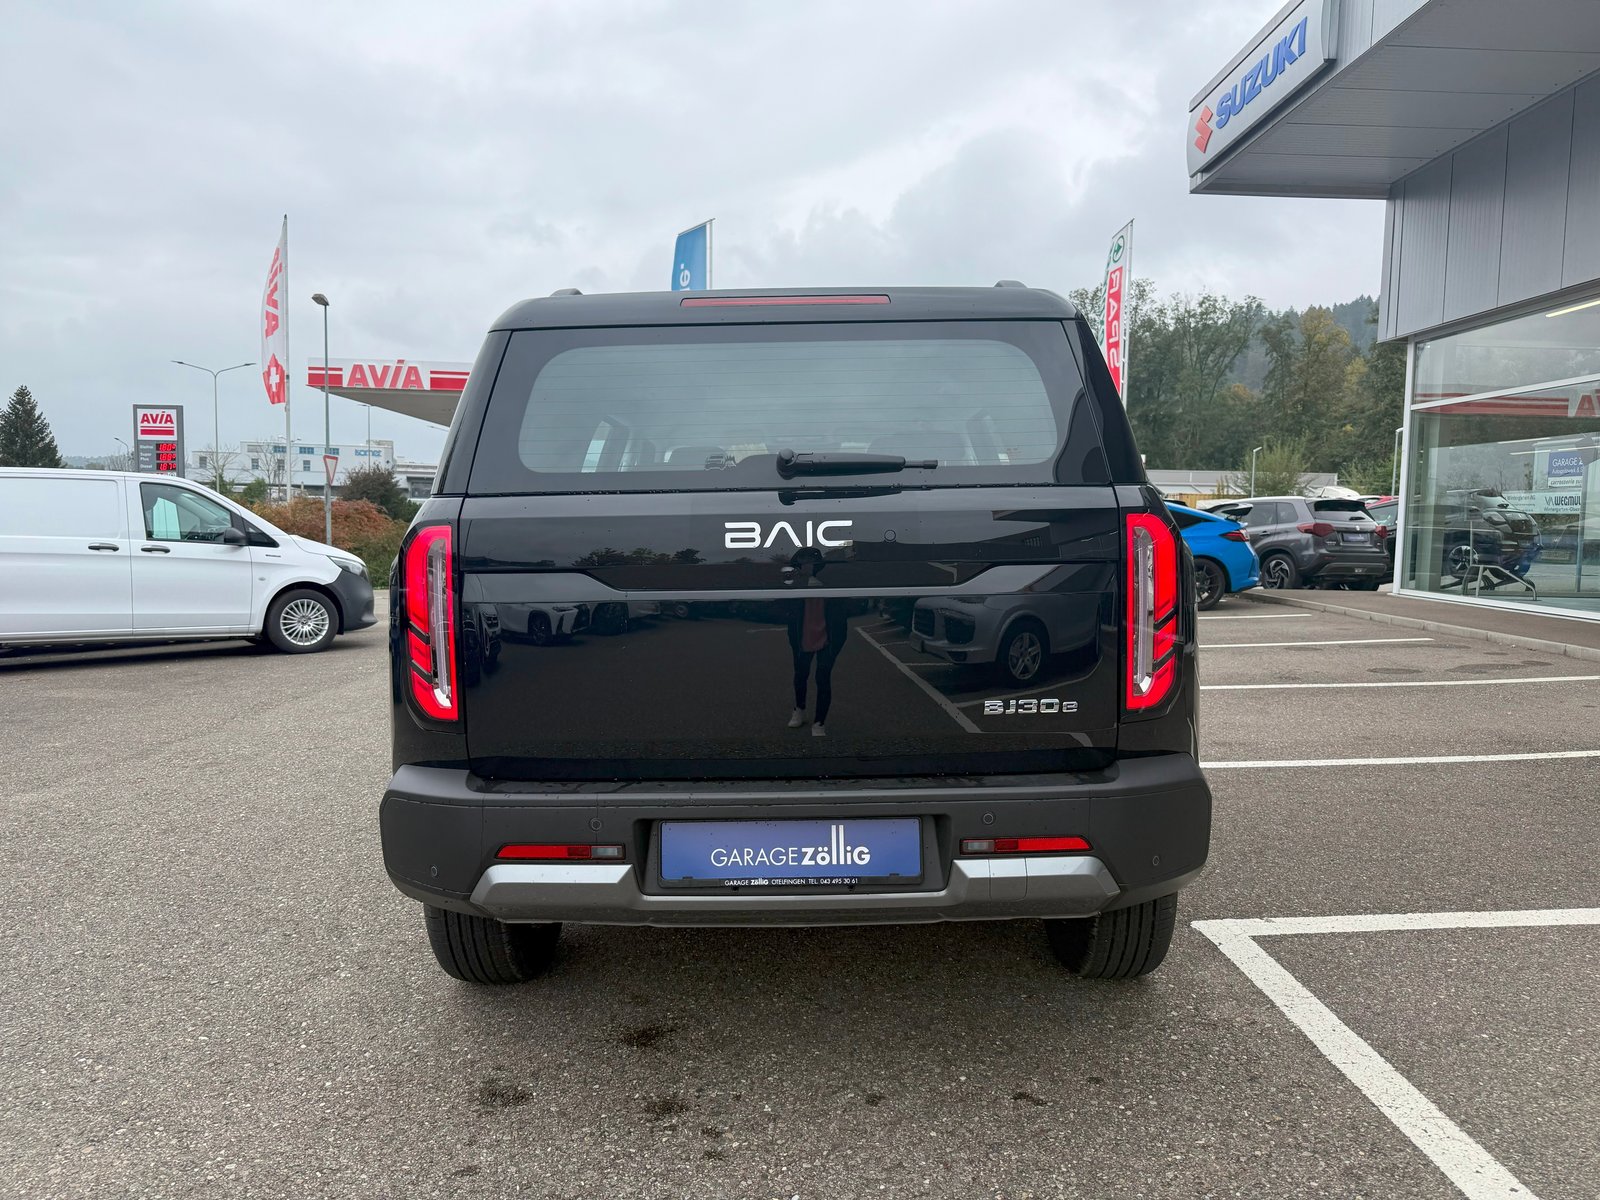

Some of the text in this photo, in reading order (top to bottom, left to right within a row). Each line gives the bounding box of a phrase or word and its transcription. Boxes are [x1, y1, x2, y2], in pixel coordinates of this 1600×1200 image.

[1216, 16, 1307, 129] SUZUKI
[347, 359, 425, 390] AVIA
[140, 410, 174, 424] AVIA
[724, 519, 854, 549] BAIC
[710, 847, 798, 867] GARAGE
